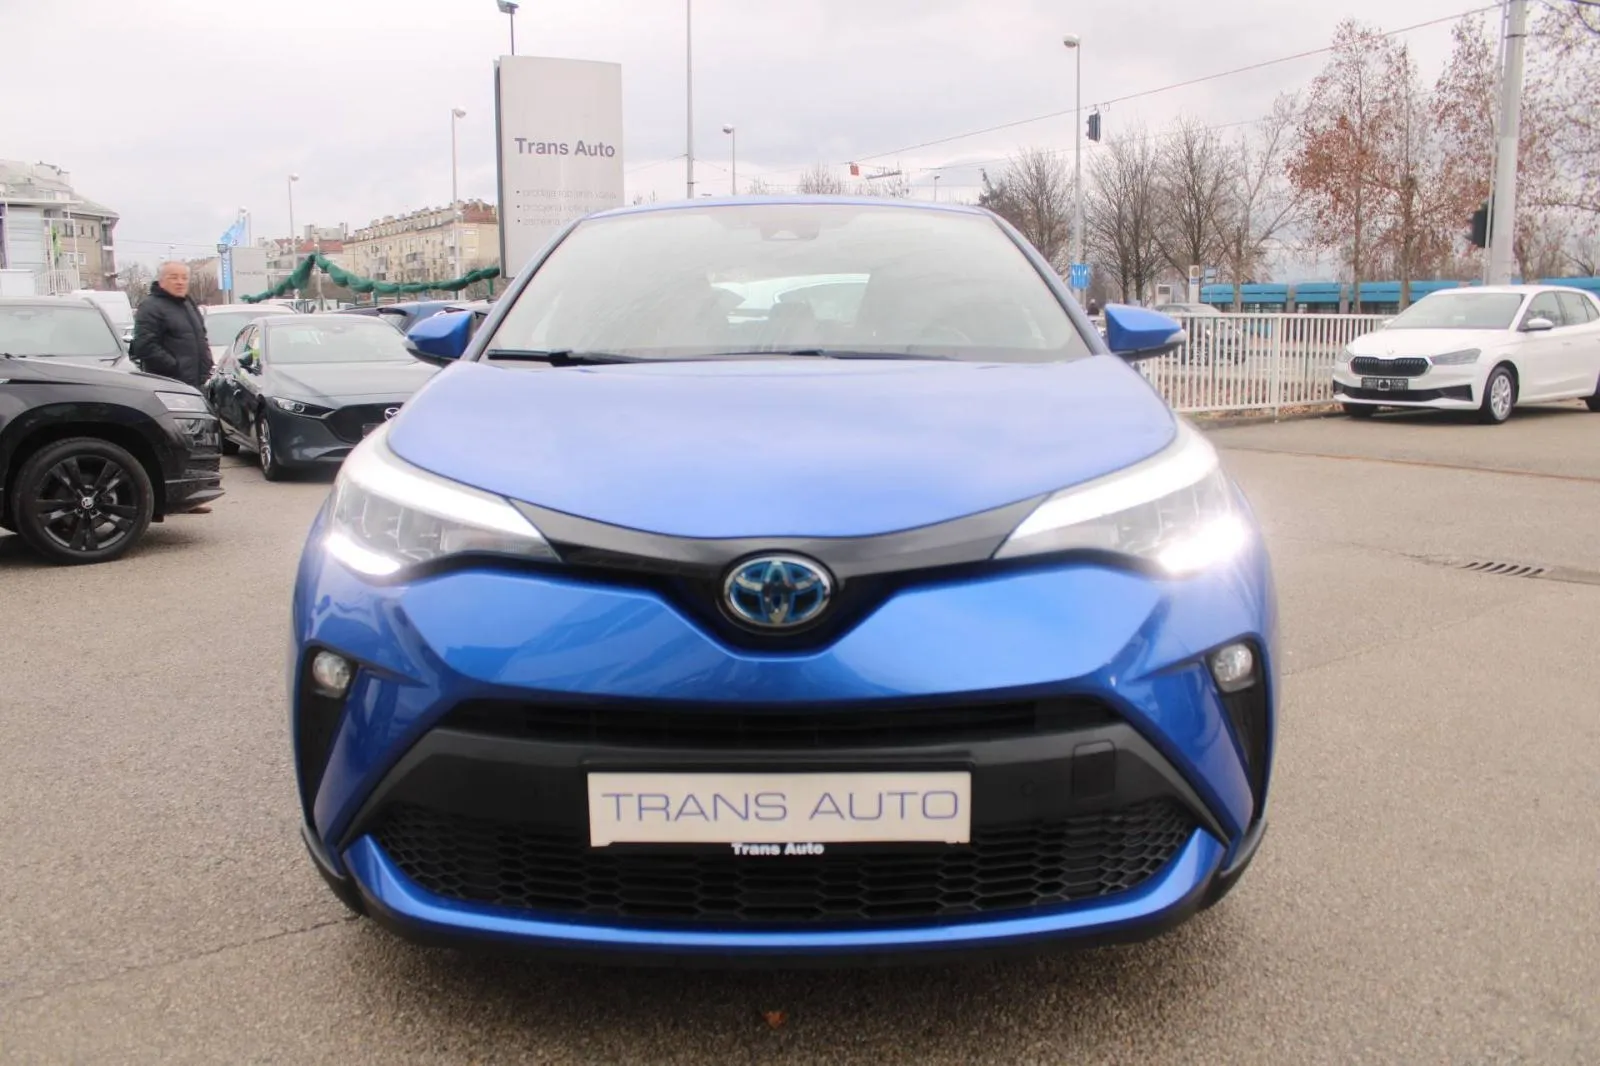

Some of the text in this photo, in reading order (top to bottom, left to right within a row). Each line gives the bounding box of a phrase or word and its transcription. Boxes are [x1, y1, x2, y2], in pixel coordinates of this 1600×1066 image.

[514, 137, 616, 158] Trans Auto
[601, 789, 960, 823] TRANS AUTO
[731, 842, 825, 856] Trans Auto
